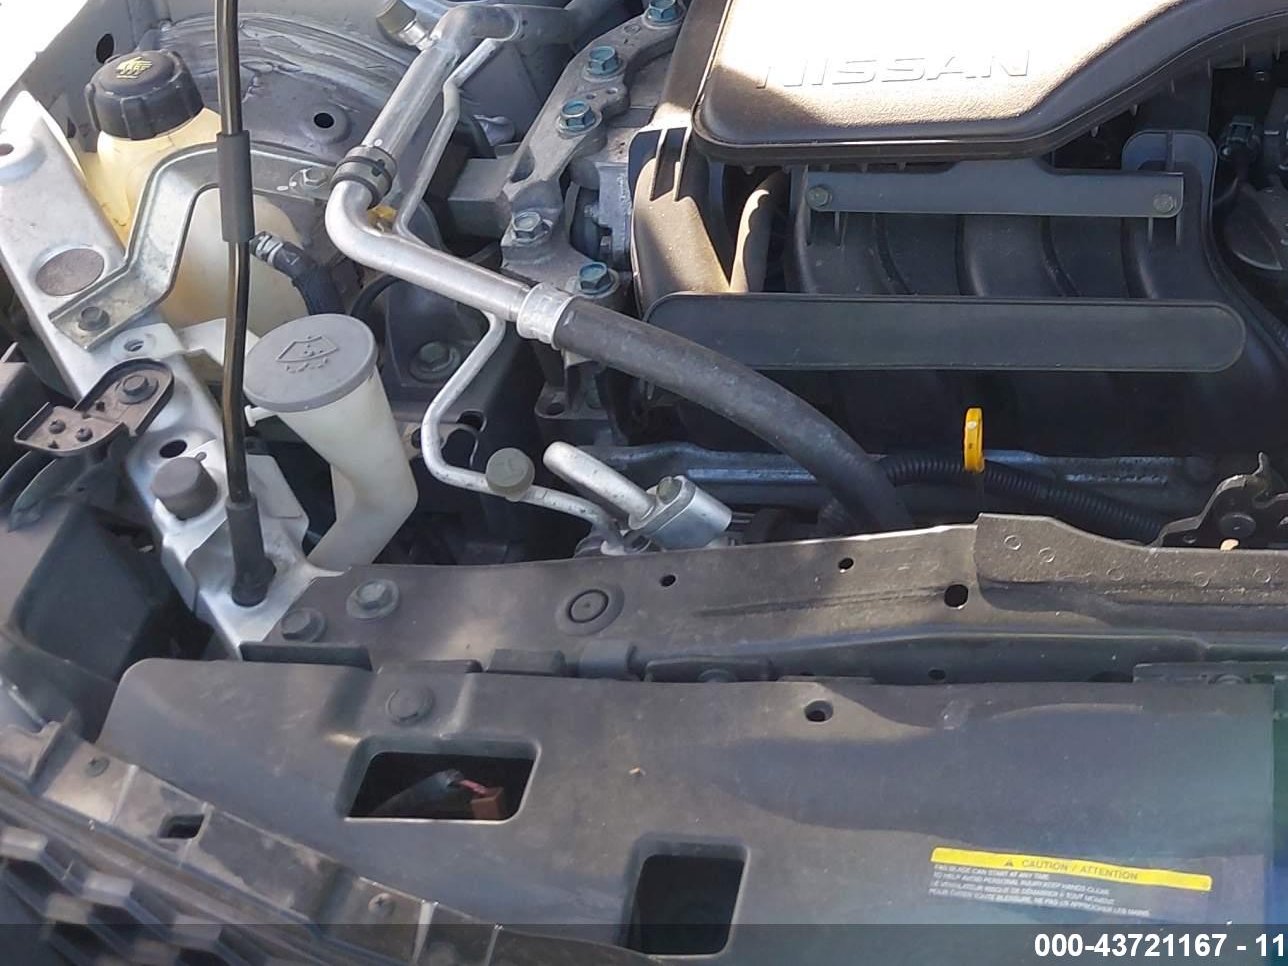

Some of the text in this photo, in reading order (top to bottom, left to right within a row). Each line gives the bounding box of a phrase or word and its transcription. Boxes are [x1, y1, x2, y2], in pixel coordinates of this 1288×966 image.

[756, 50, 1030, 89] NISSAN
[1021, 859, 1068, 872] CAUTION
[1079, 866, 1138, 881] ATTENTION
